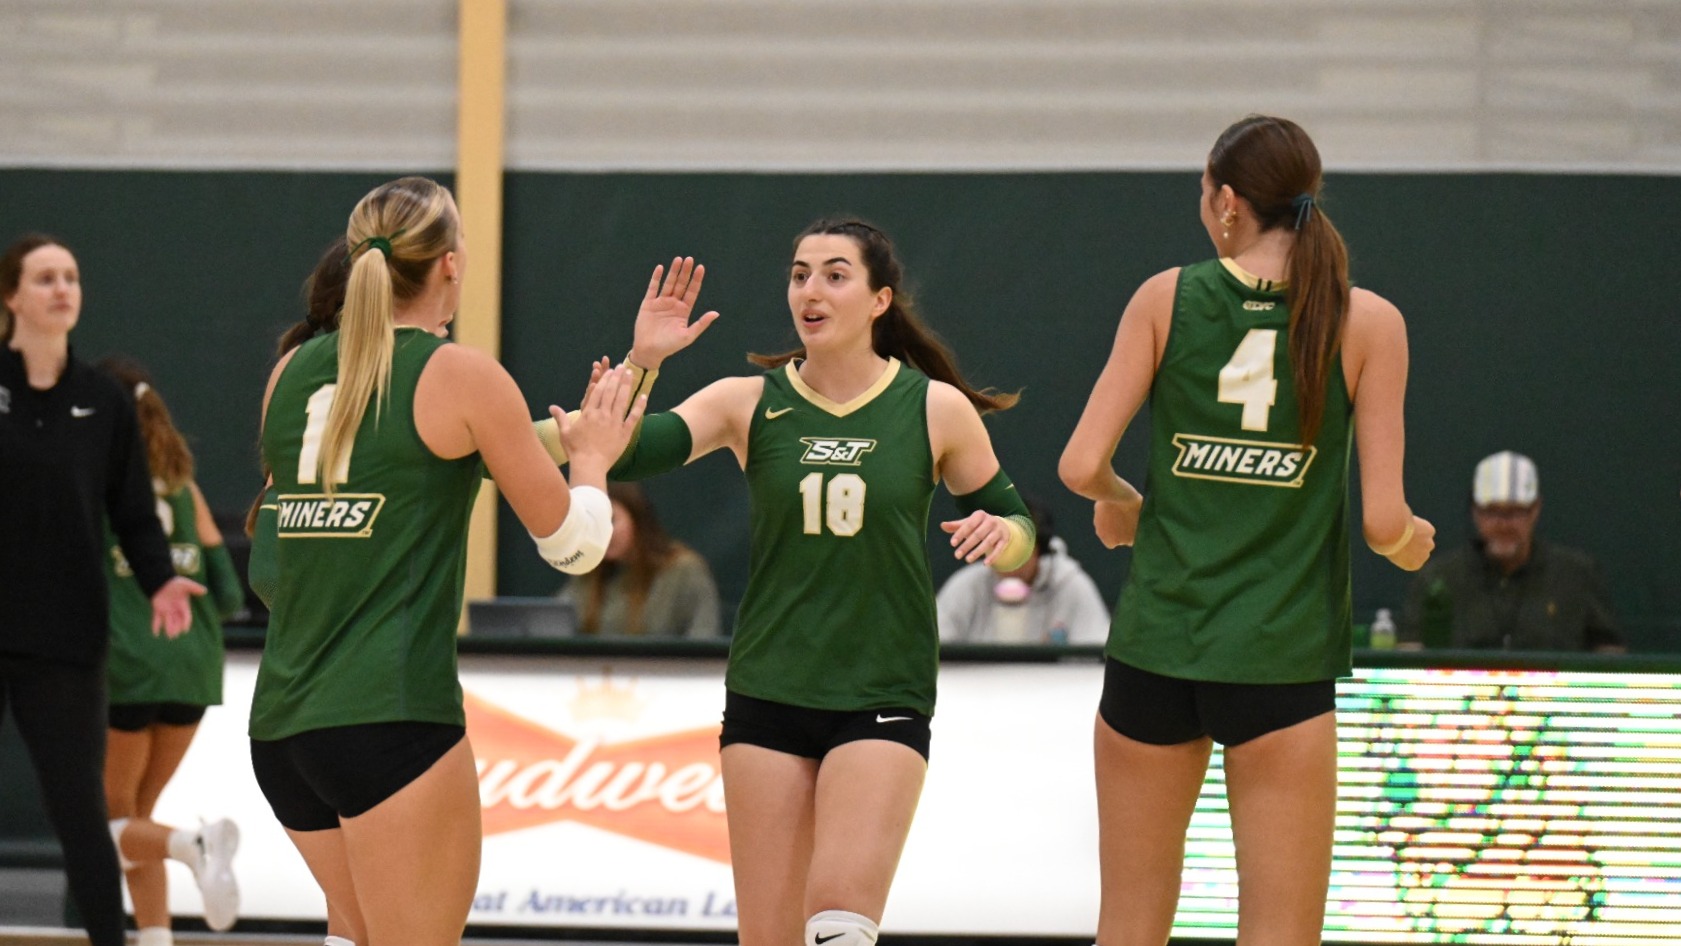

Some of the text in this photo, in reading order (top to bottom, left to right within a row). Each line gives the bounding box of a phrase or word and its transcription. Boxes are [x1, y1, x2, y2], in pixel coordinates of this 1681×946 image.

[1217, 328, 1278, 432] 4
[805, 440, 871, 461] S&T
[1182, 442, 1304, 477] MINERS
[278, 501, 372, 528] MINERS
[799, 472, 867, 537] 18
[517, 887, 689, 916] American
